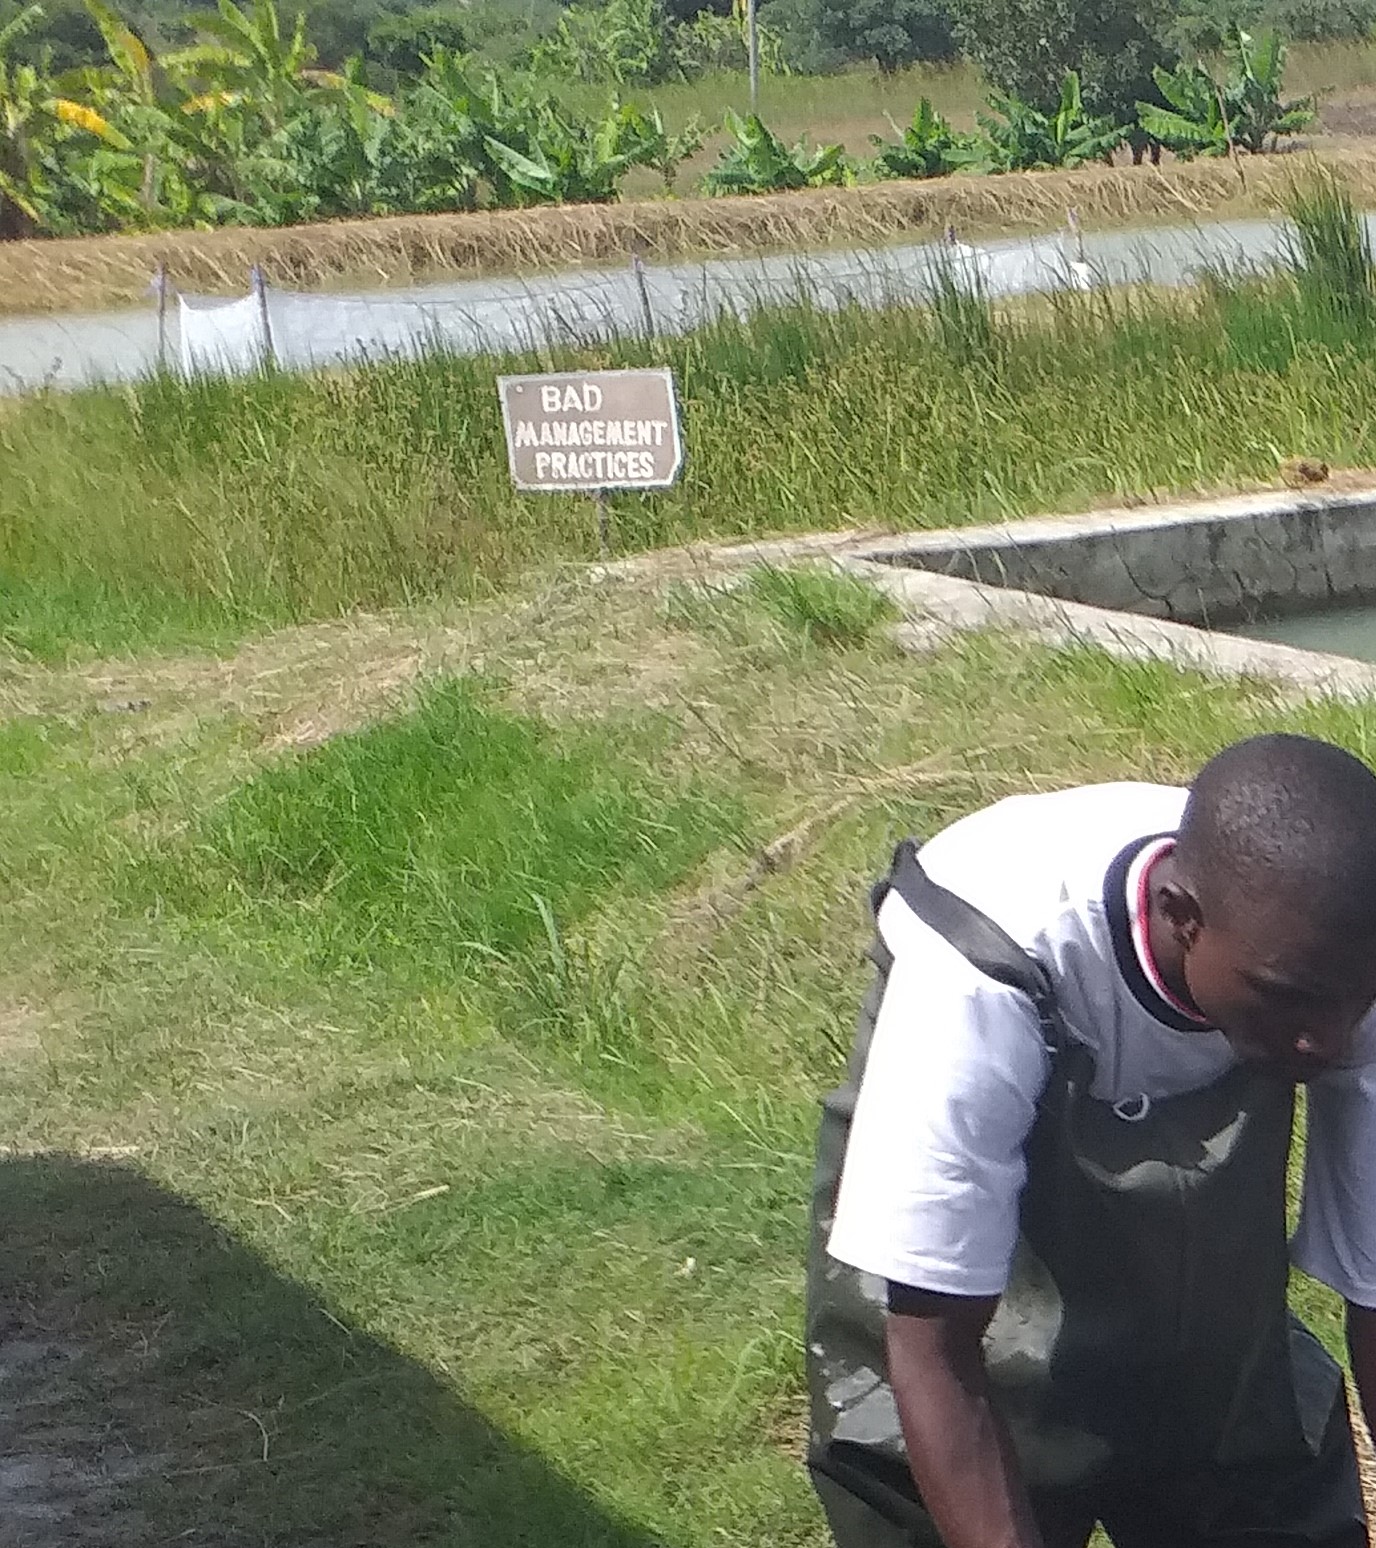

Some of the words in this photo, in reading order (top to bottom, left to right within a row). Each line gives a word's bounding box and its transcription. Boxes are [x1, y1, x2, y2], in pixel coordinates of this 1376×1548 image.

[541, 381, 603, 412] BAD
[515, 419, 667, 448] MANAGEMENT
[535, 451, 654, 479] PRACTICES
